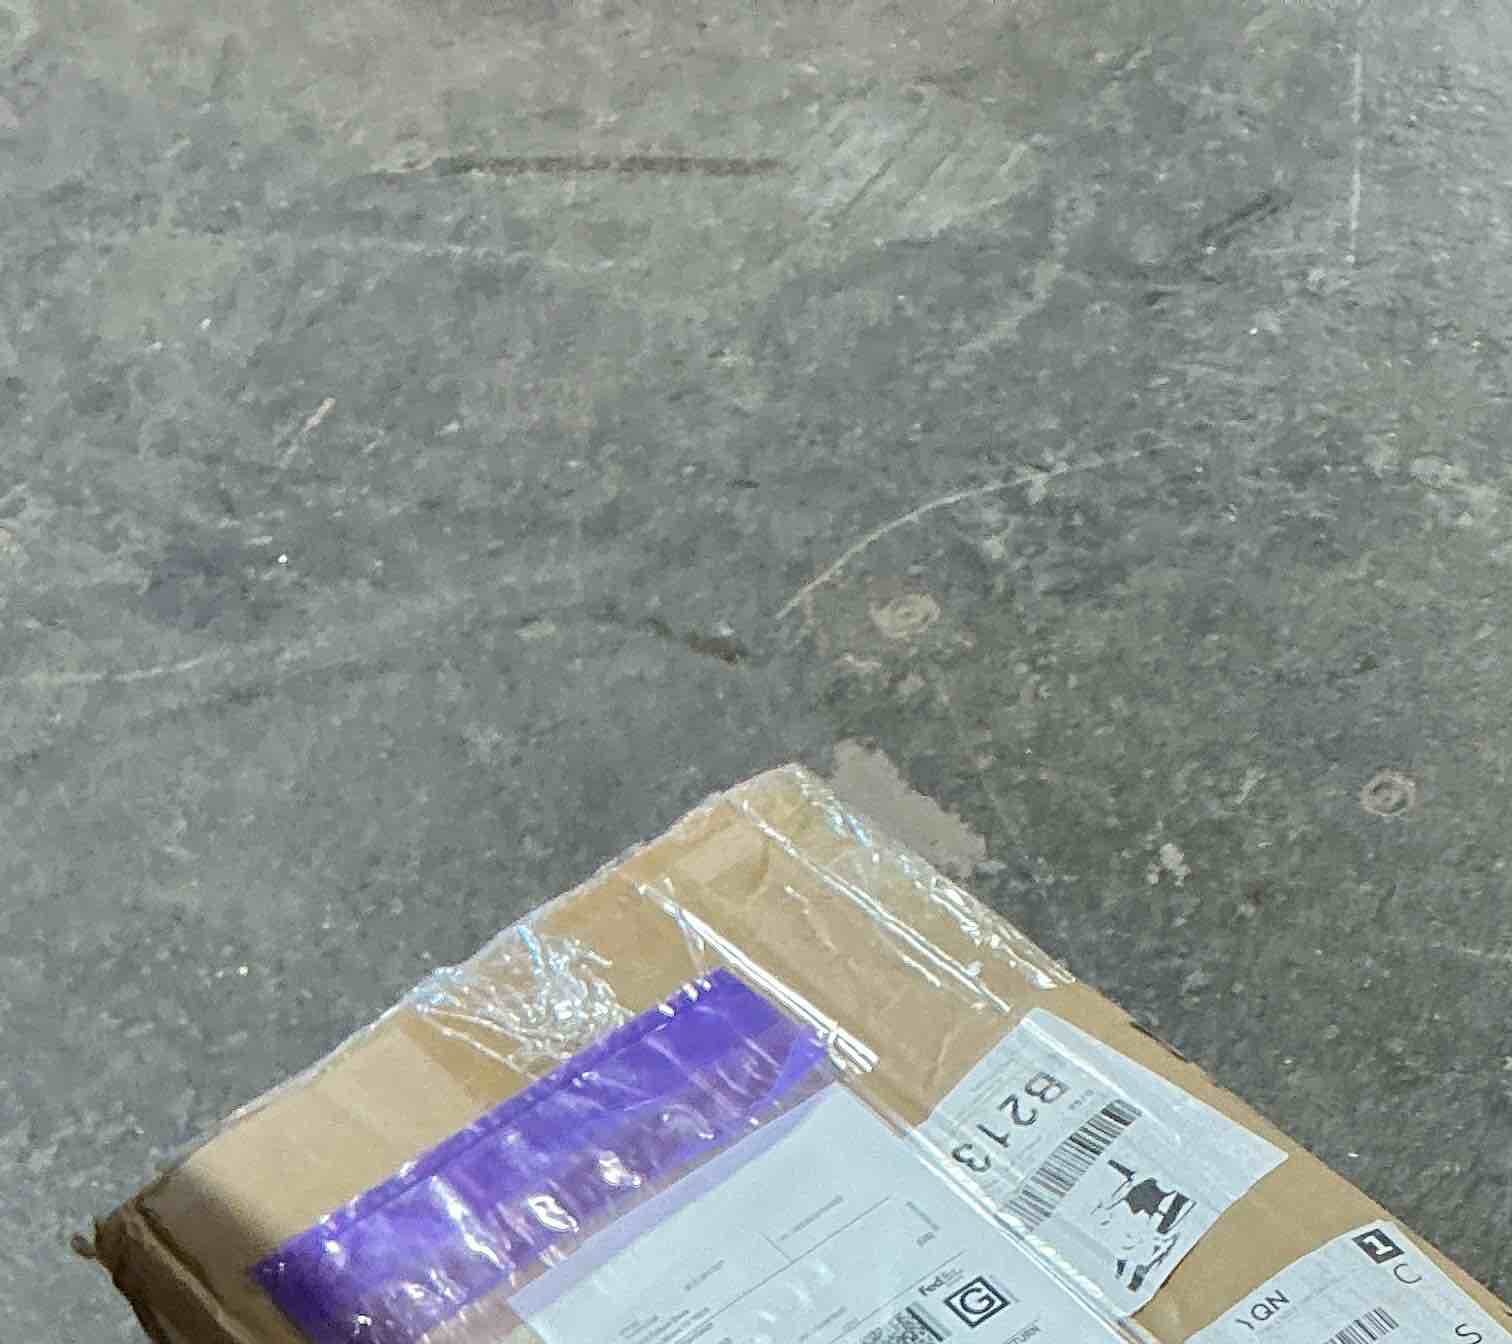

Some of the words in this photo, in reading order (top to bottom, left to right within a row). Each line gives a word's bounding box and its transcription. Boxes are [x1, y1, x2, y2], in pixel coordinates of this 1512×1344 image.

[952, 1070, 1068, 1173] B213
[1392, 1262, 1423, 1285] C
[959, 1287, 996, 1315] G
